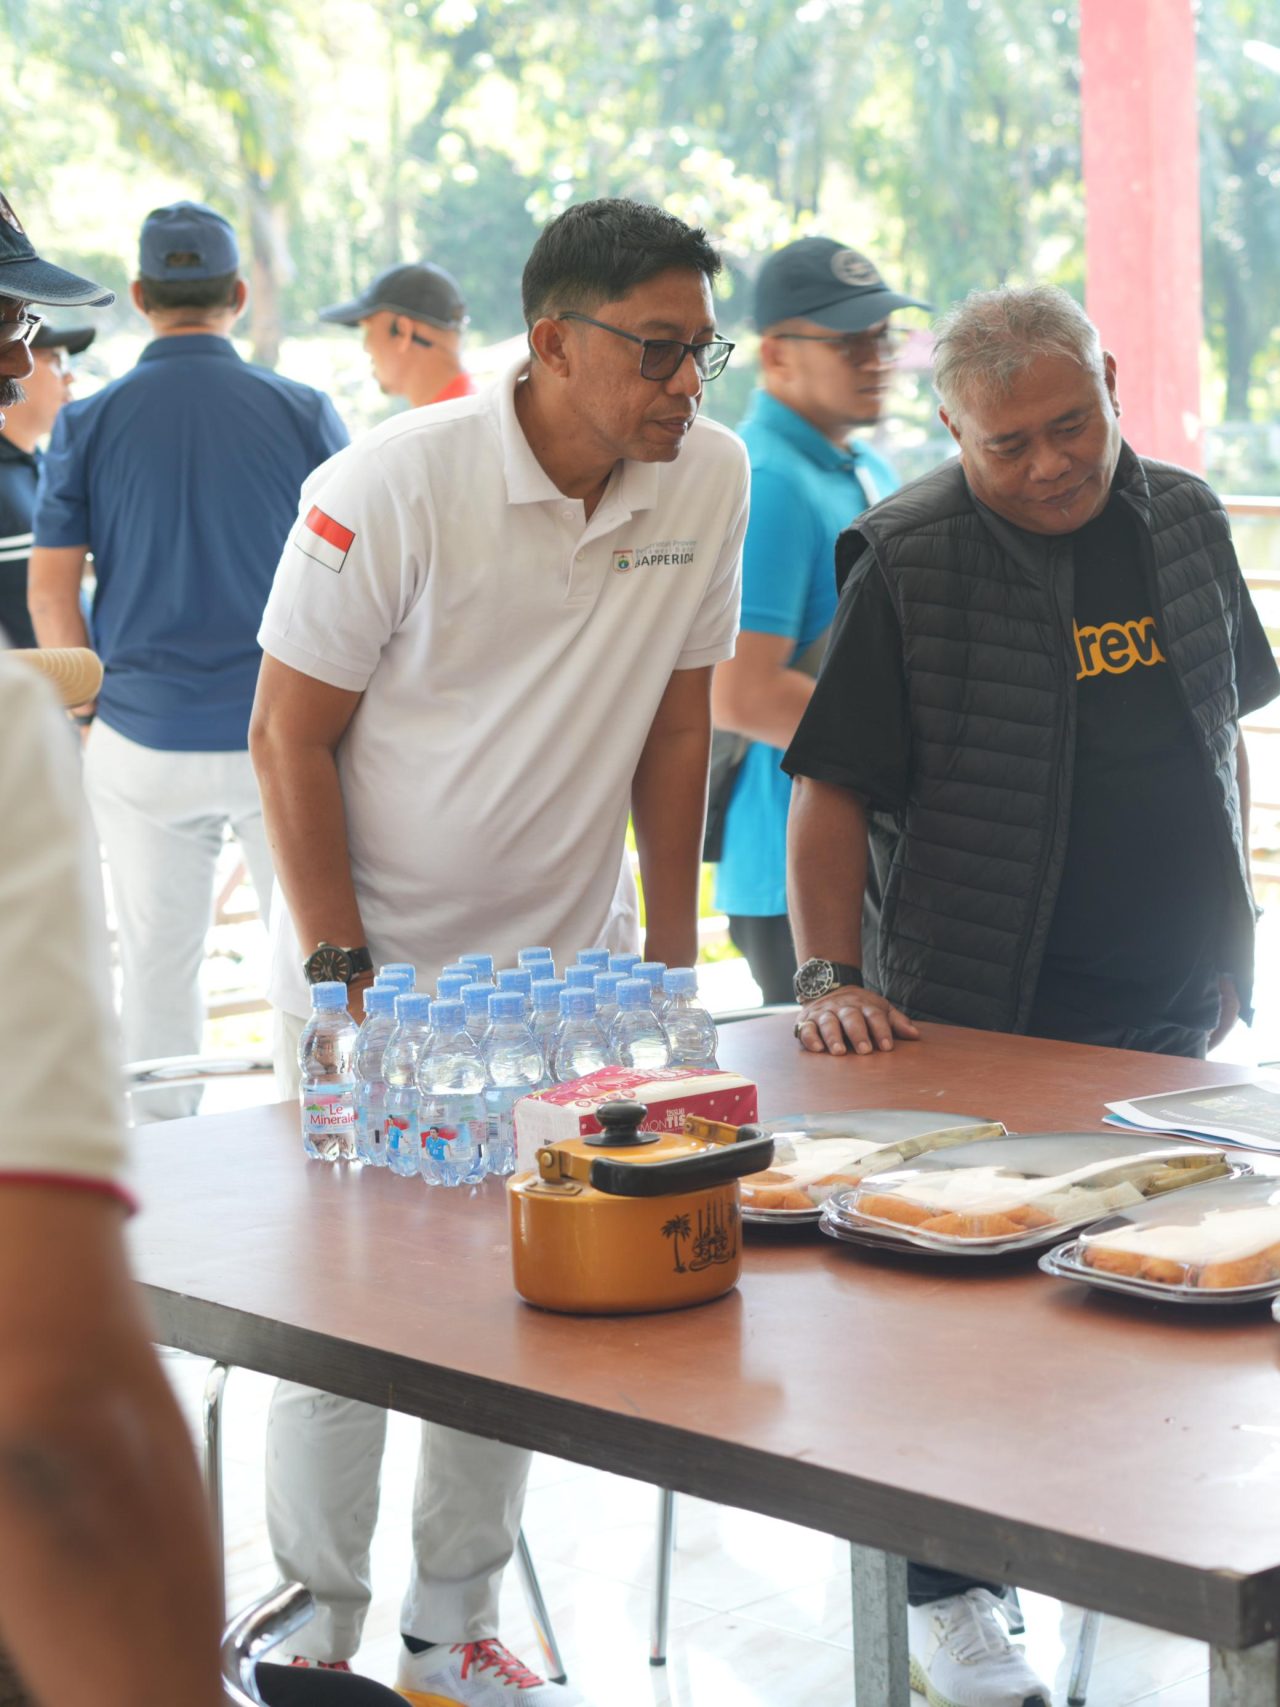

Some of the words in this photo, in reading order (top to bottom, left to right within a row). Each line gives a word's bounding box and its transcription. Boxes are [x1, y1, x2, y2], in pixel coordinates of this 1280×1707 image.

[1073, 616, 1166, 680] rew
[329, 1103, 343, 1115] Le
[310, 1112, 356, 1125] Minerale
[640, 1114, 687, 1133] MONTIS
